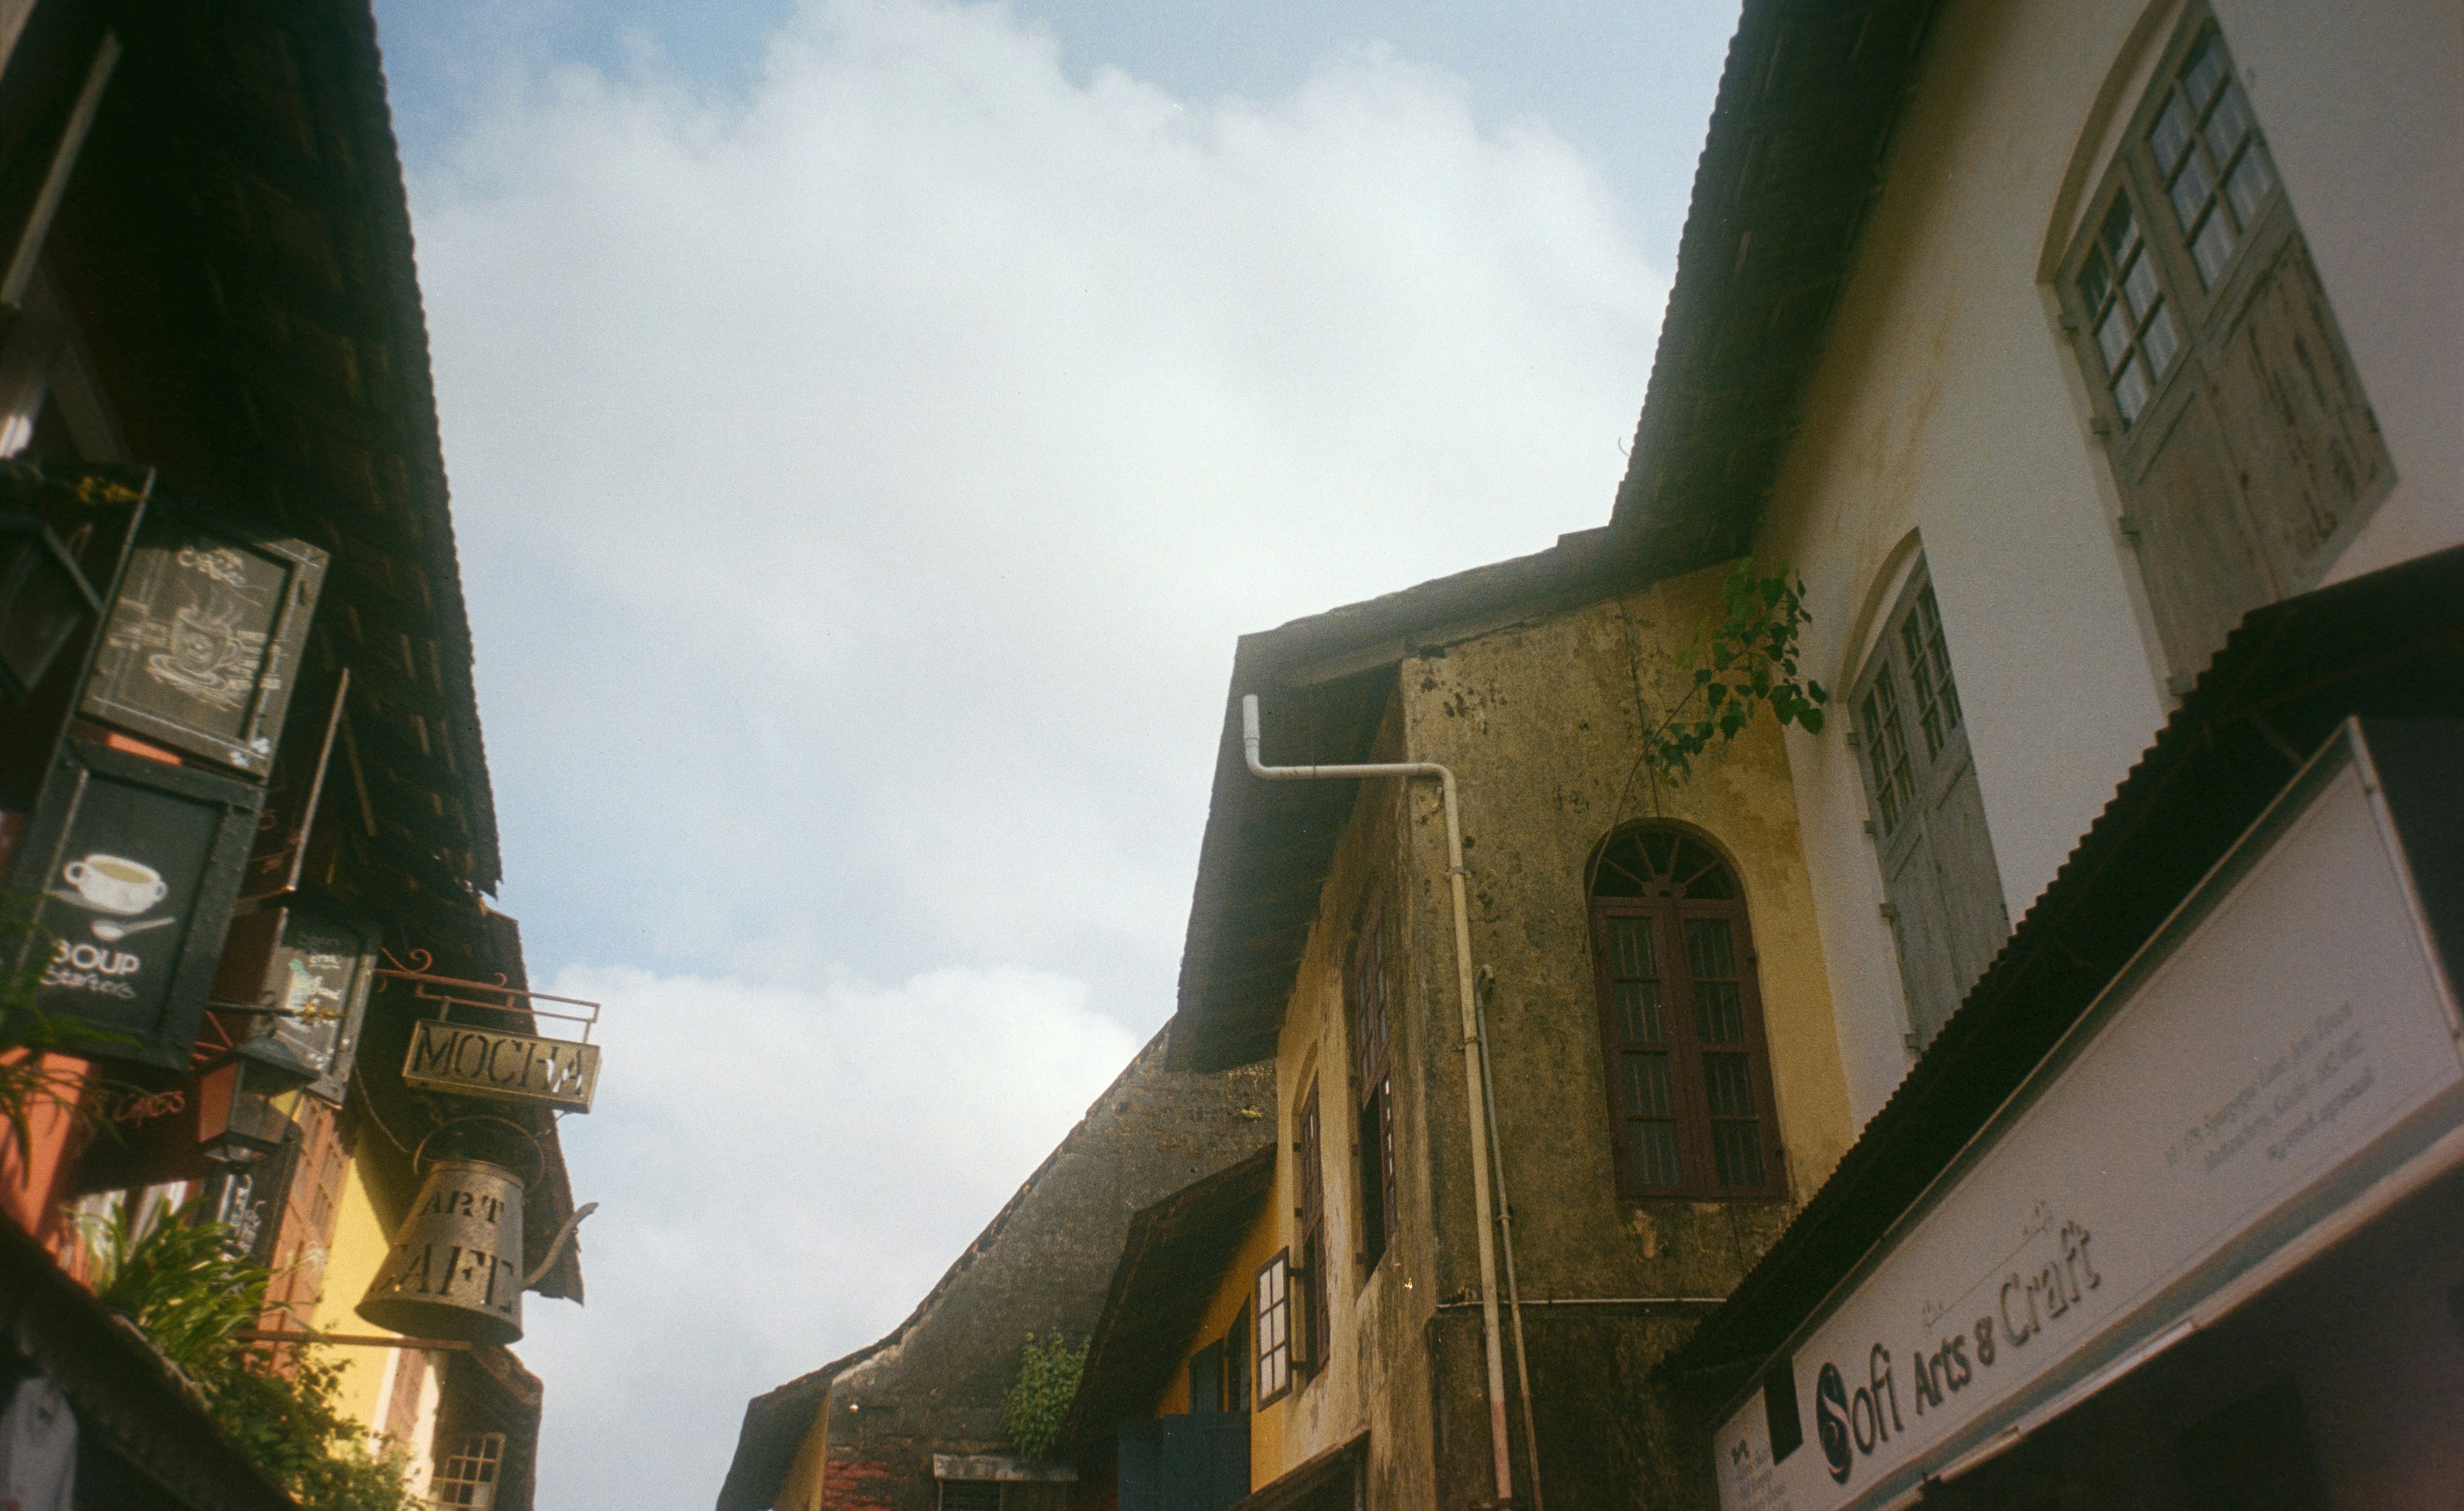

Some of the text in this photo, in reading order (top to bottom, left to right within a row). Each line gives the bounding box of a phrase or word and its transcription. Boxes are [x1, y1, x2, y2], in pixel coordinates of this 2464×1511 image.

[412, 1027, 584, 1096] MOCHA
[420, 1191, 505, 1223] ART
[1816, 1342, 1904, 1485] Sofi
[1913, 1334, 1971, 1416] Arts
[1998, 1220, 2101, 1348] Craft
